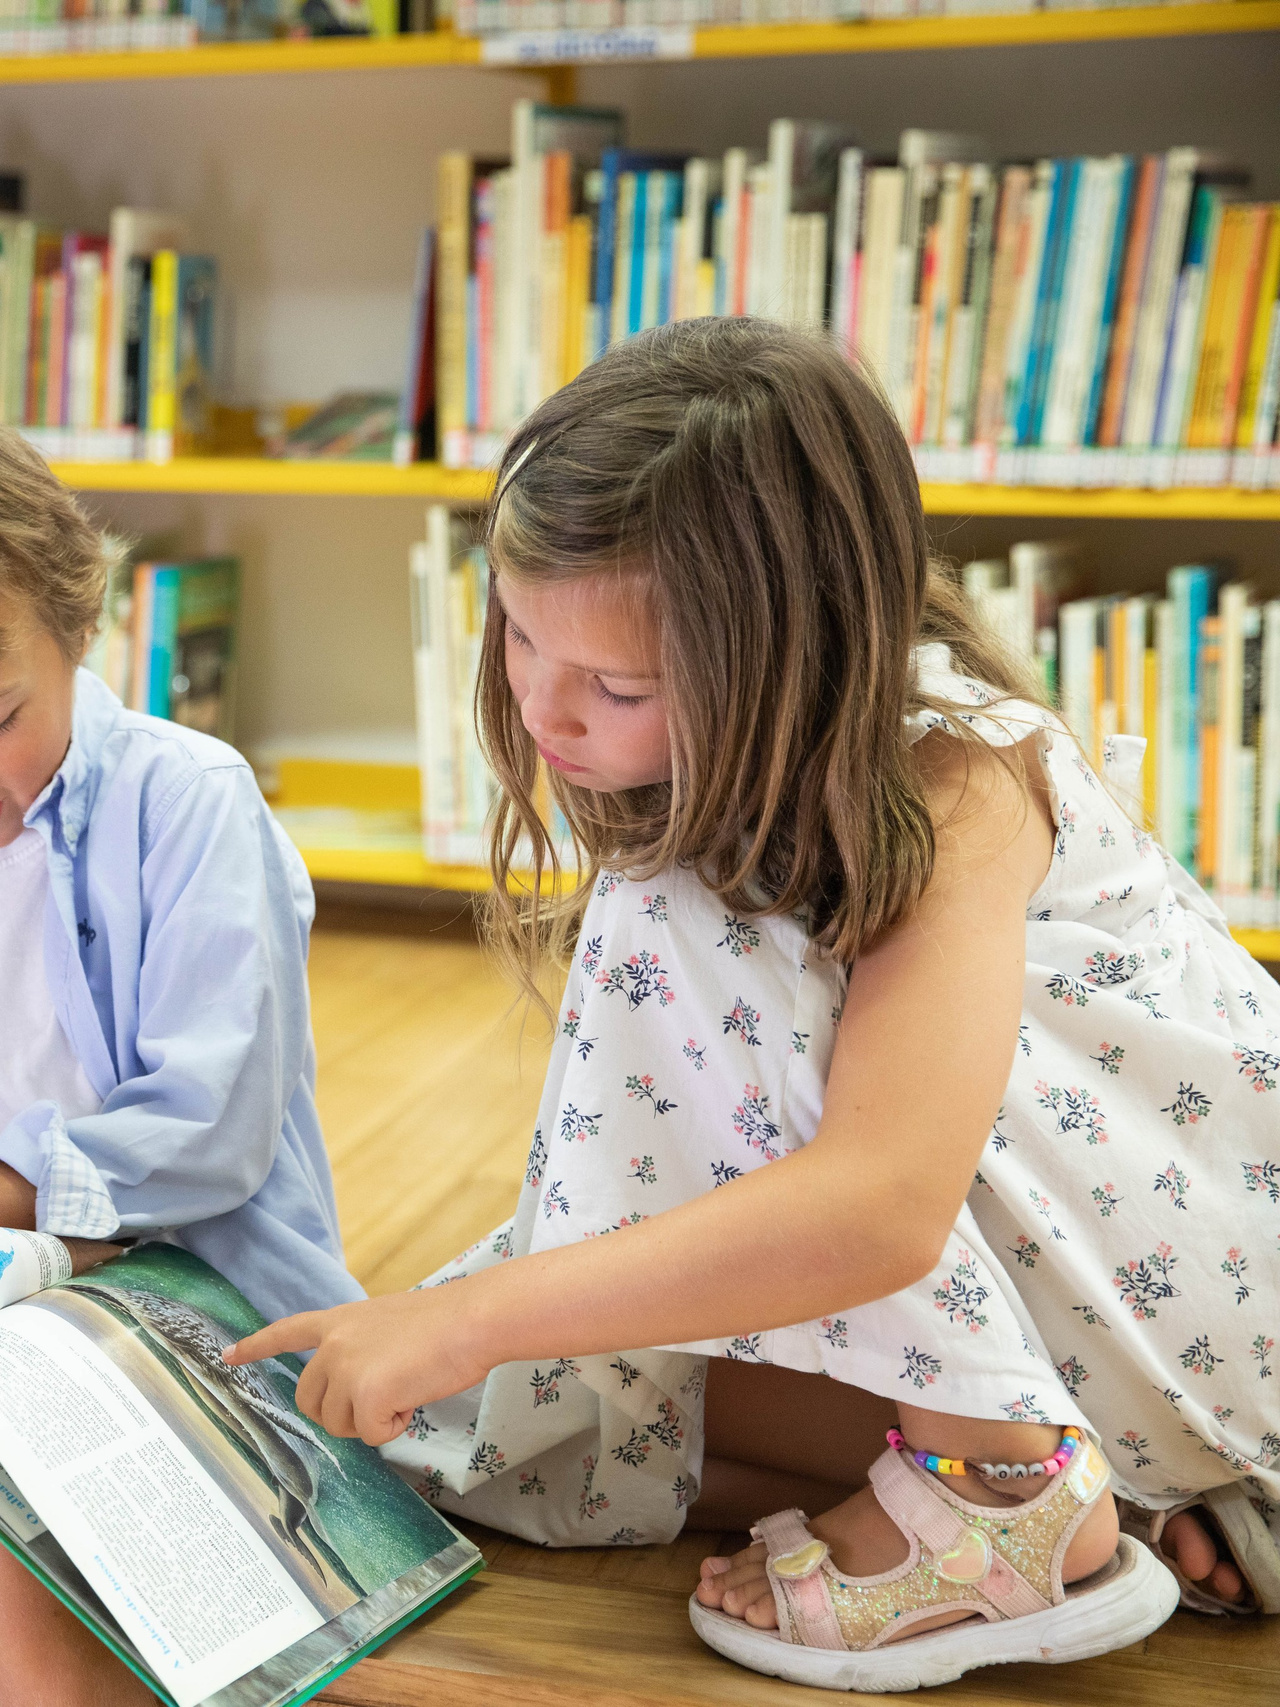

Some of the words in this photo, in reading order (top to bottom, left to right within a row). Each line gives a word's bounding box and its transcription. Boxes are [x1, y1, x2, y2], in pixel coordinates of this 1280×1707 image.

[24, 1511, 39, 1526] O
[91, 1553, 171, 1656] baleia-de-bossa
[170, 1658, 184, 1672] A
